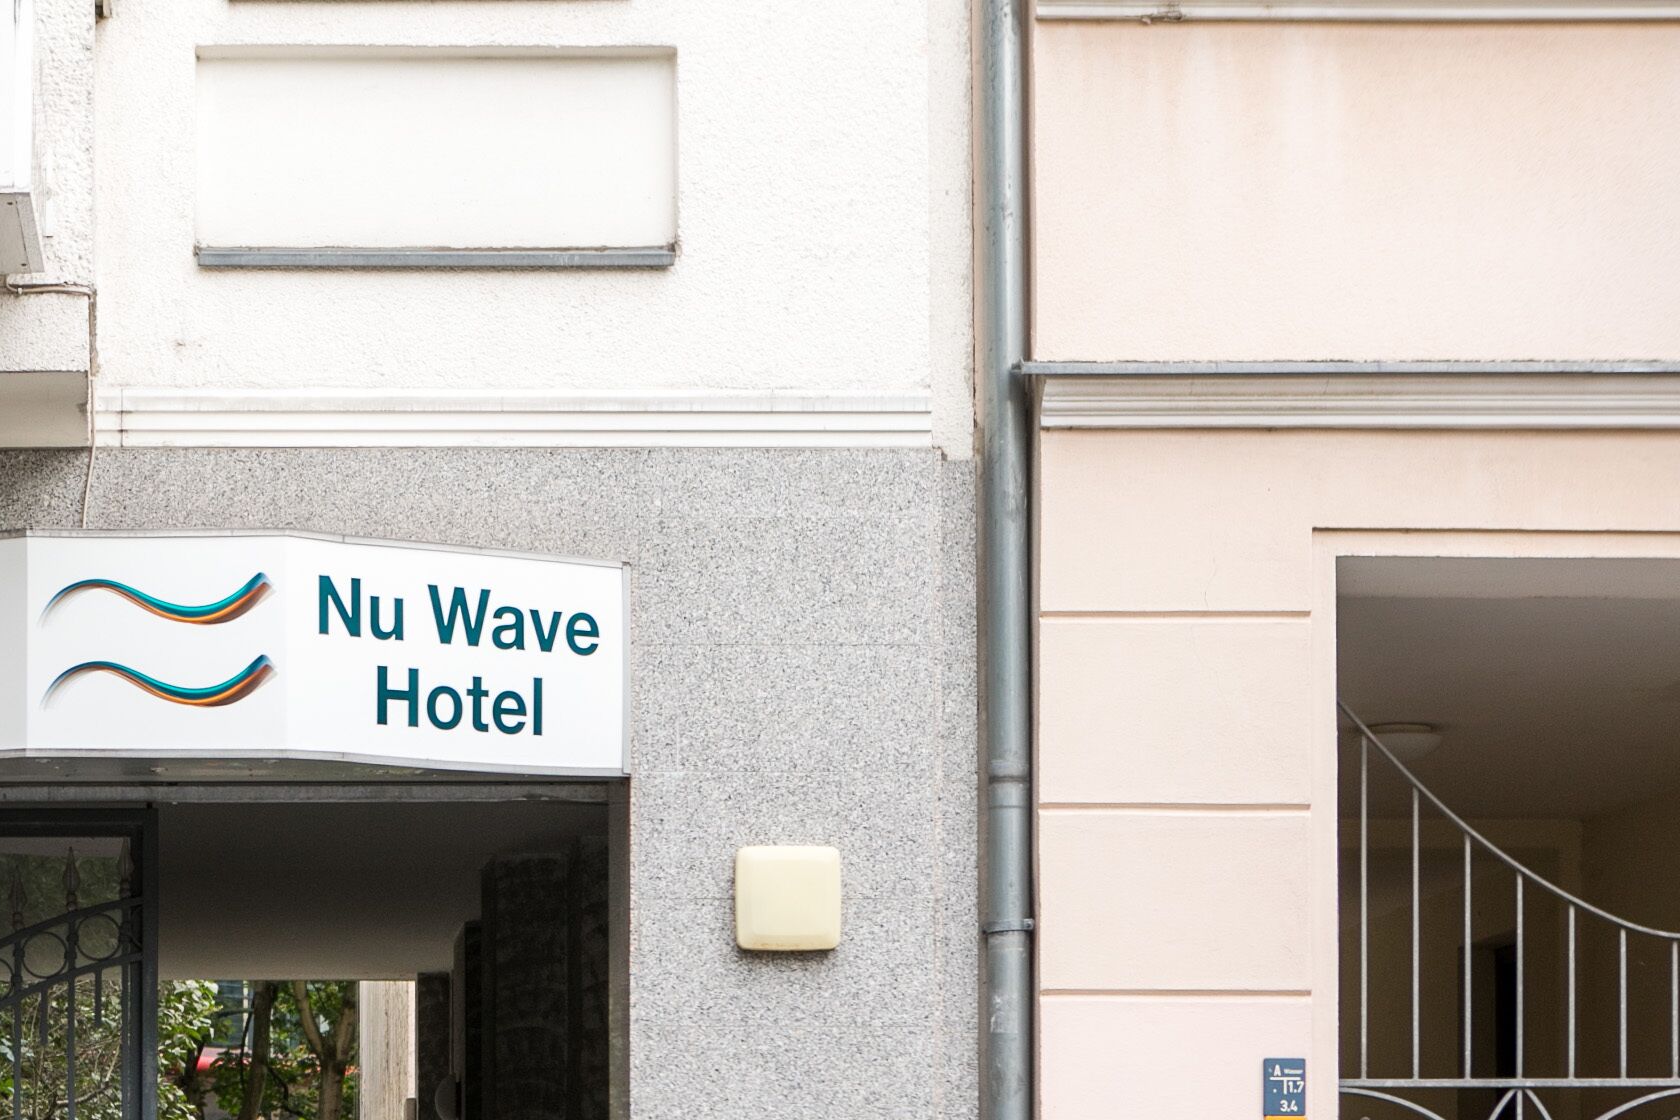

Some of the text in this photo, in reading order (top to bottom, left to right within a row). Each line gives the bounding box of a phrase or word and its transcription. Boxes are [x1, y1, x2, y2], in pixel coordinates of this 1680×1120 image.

[318, 575, 600, 656] Nu Wave
[376, 665, 543, 736] Hotel
